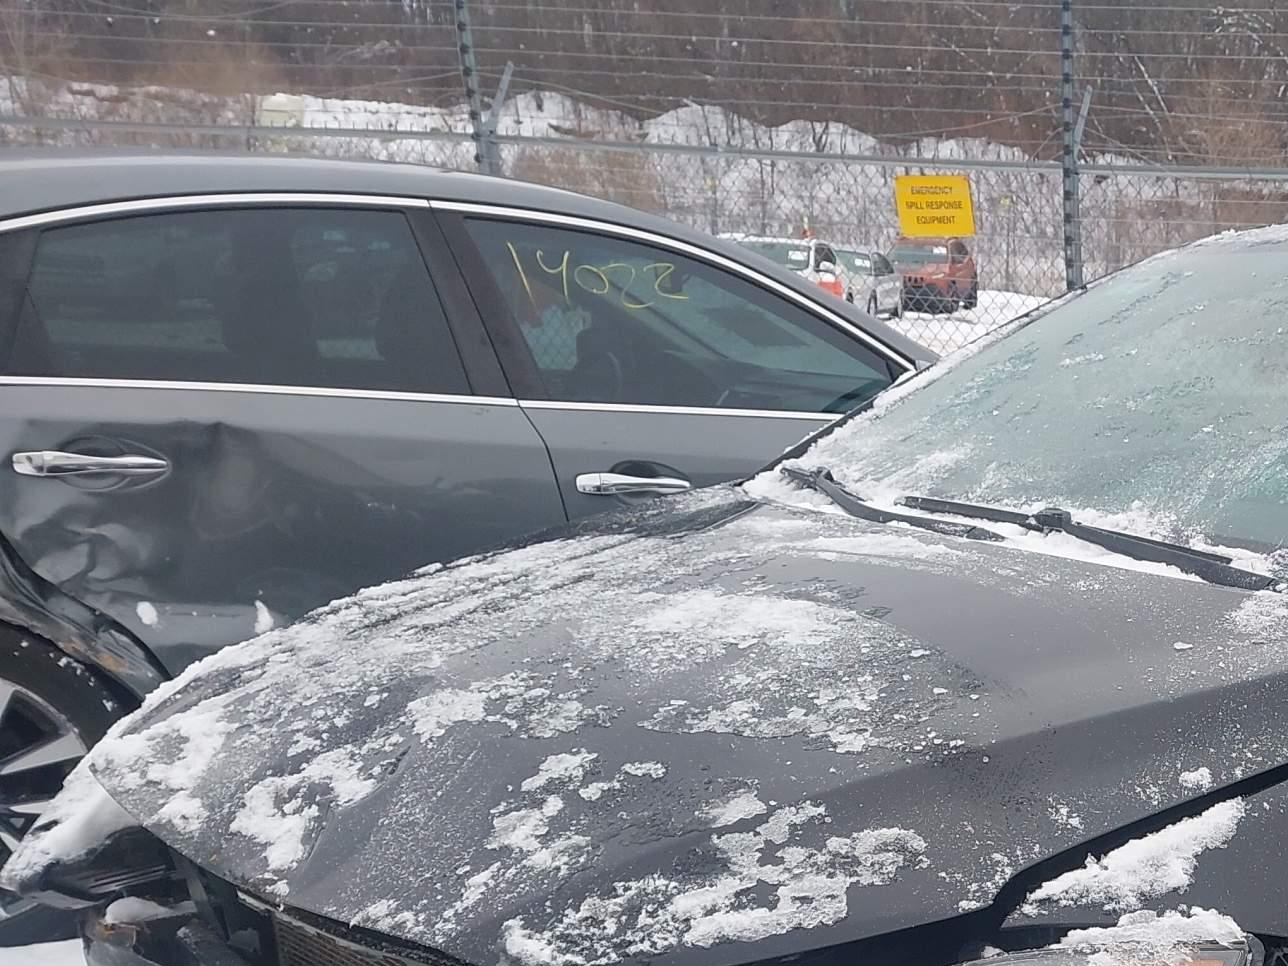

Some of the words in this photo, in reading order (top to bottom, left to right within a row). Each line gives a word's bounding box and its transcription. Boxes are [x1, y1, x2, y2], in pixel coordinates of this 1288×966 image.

[911, 186, 953, 195] EMERGENCY
[905, 201, 924, 210] SPILL
[926, 201, 963, 210] RESPONSE
[916, 215, 955, 225] EQUIPMENT
[506, 241, 689, 308] 14022
